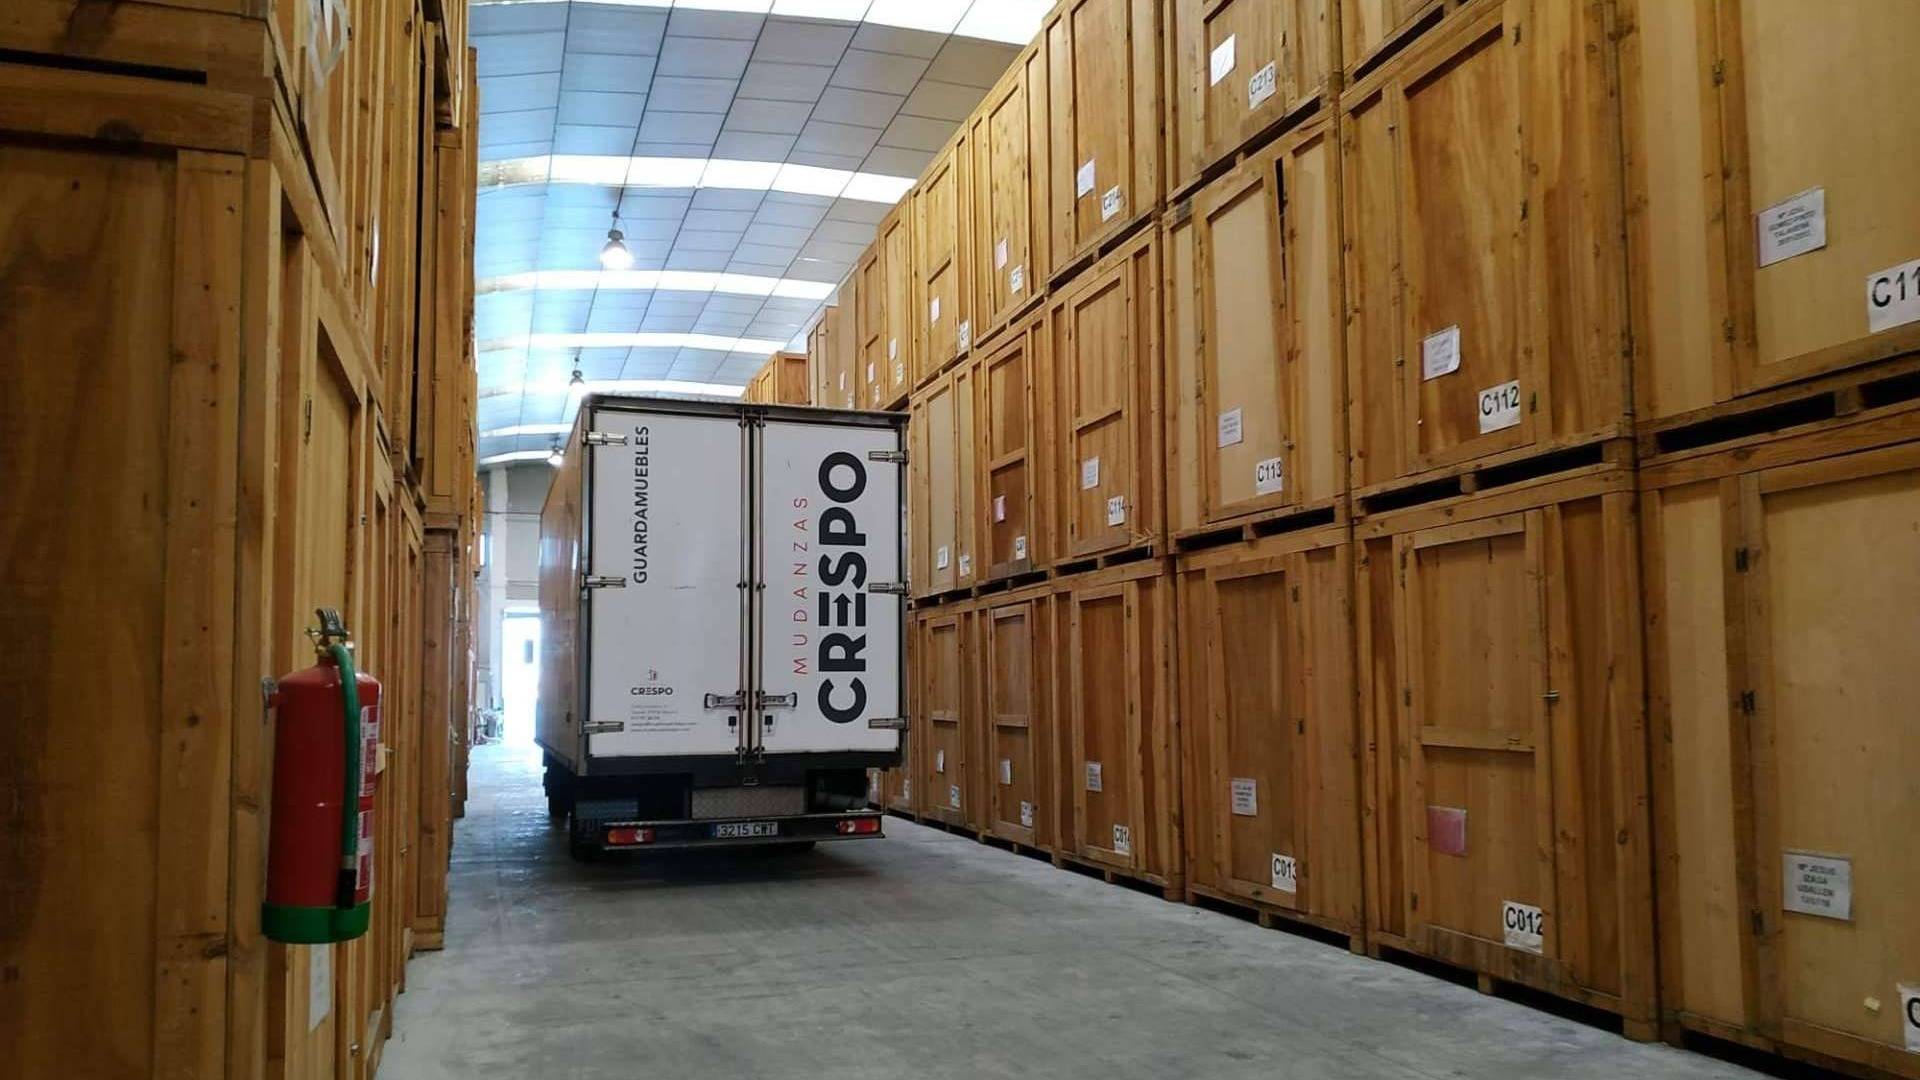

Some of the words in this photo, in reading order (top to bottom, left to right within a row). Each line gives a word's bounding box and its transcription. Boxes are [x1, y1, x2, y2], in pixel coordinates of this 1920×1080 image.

[1481, 385, 1520, 416] C112
[1257, 461, 1283, 482] C113
[633, 425, 649, 584] GUARDAMUEBLES
[793, 497, 808, 675] MUDANZAS
[818, 451, 867, 724] CRESPO
[630, 686, 674, 696] CRESPO
[720, 824, 749, 837] 3215
[1505, 906, 1544, 936] C012
